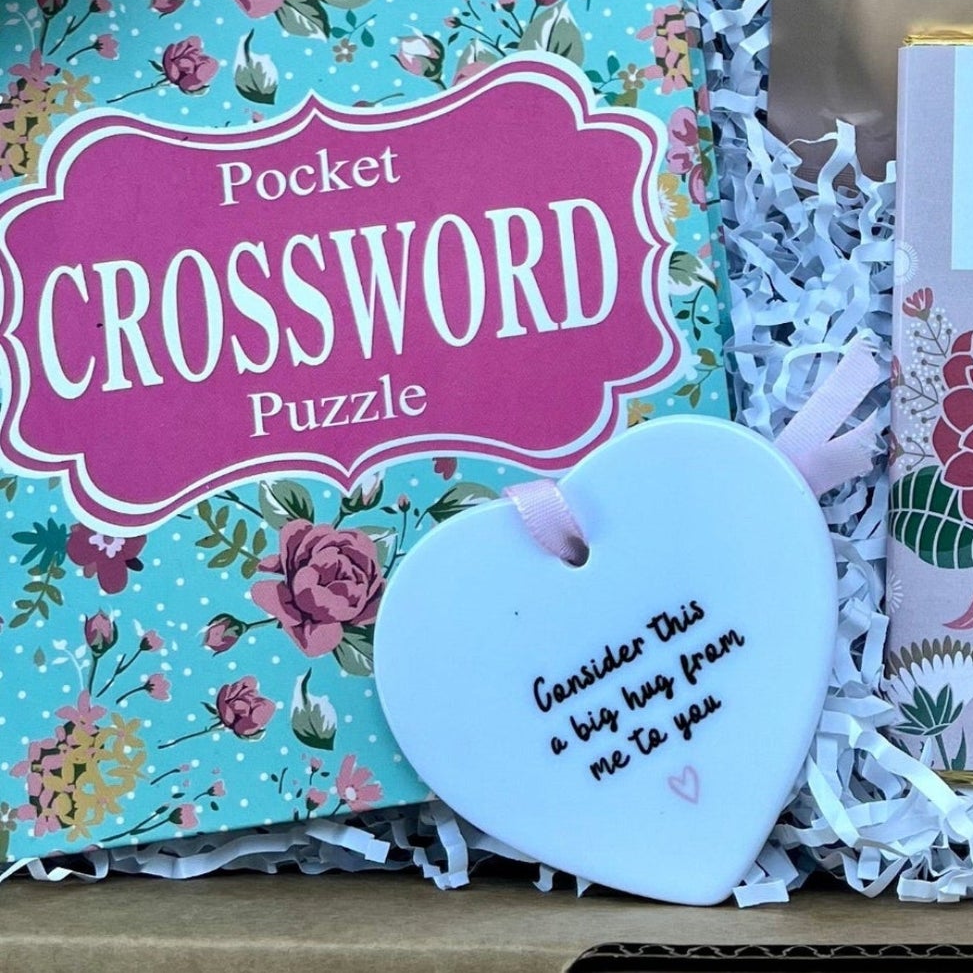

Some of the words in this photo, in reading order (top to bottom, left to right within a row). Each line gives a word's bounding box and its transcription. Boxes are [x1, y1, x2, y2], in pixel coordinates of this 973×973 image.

[217, 145, 400, 207] Pocket
[38, 198, 619, 400] CROSSWORD
[248, 375, 427, 437] Puzzle
[533, 636, 645, 713] Consider
[646, 600, 705, 643] this
[551, 736, 568, 755] a
[570, 706, 619, 742] big
[621, 674, 675, 711] hug
[680, 629, 745, 685] from
[590, 750, 631, 781] me
[627, 727, 668, 755] to
[673, 695, 722, 740] you
